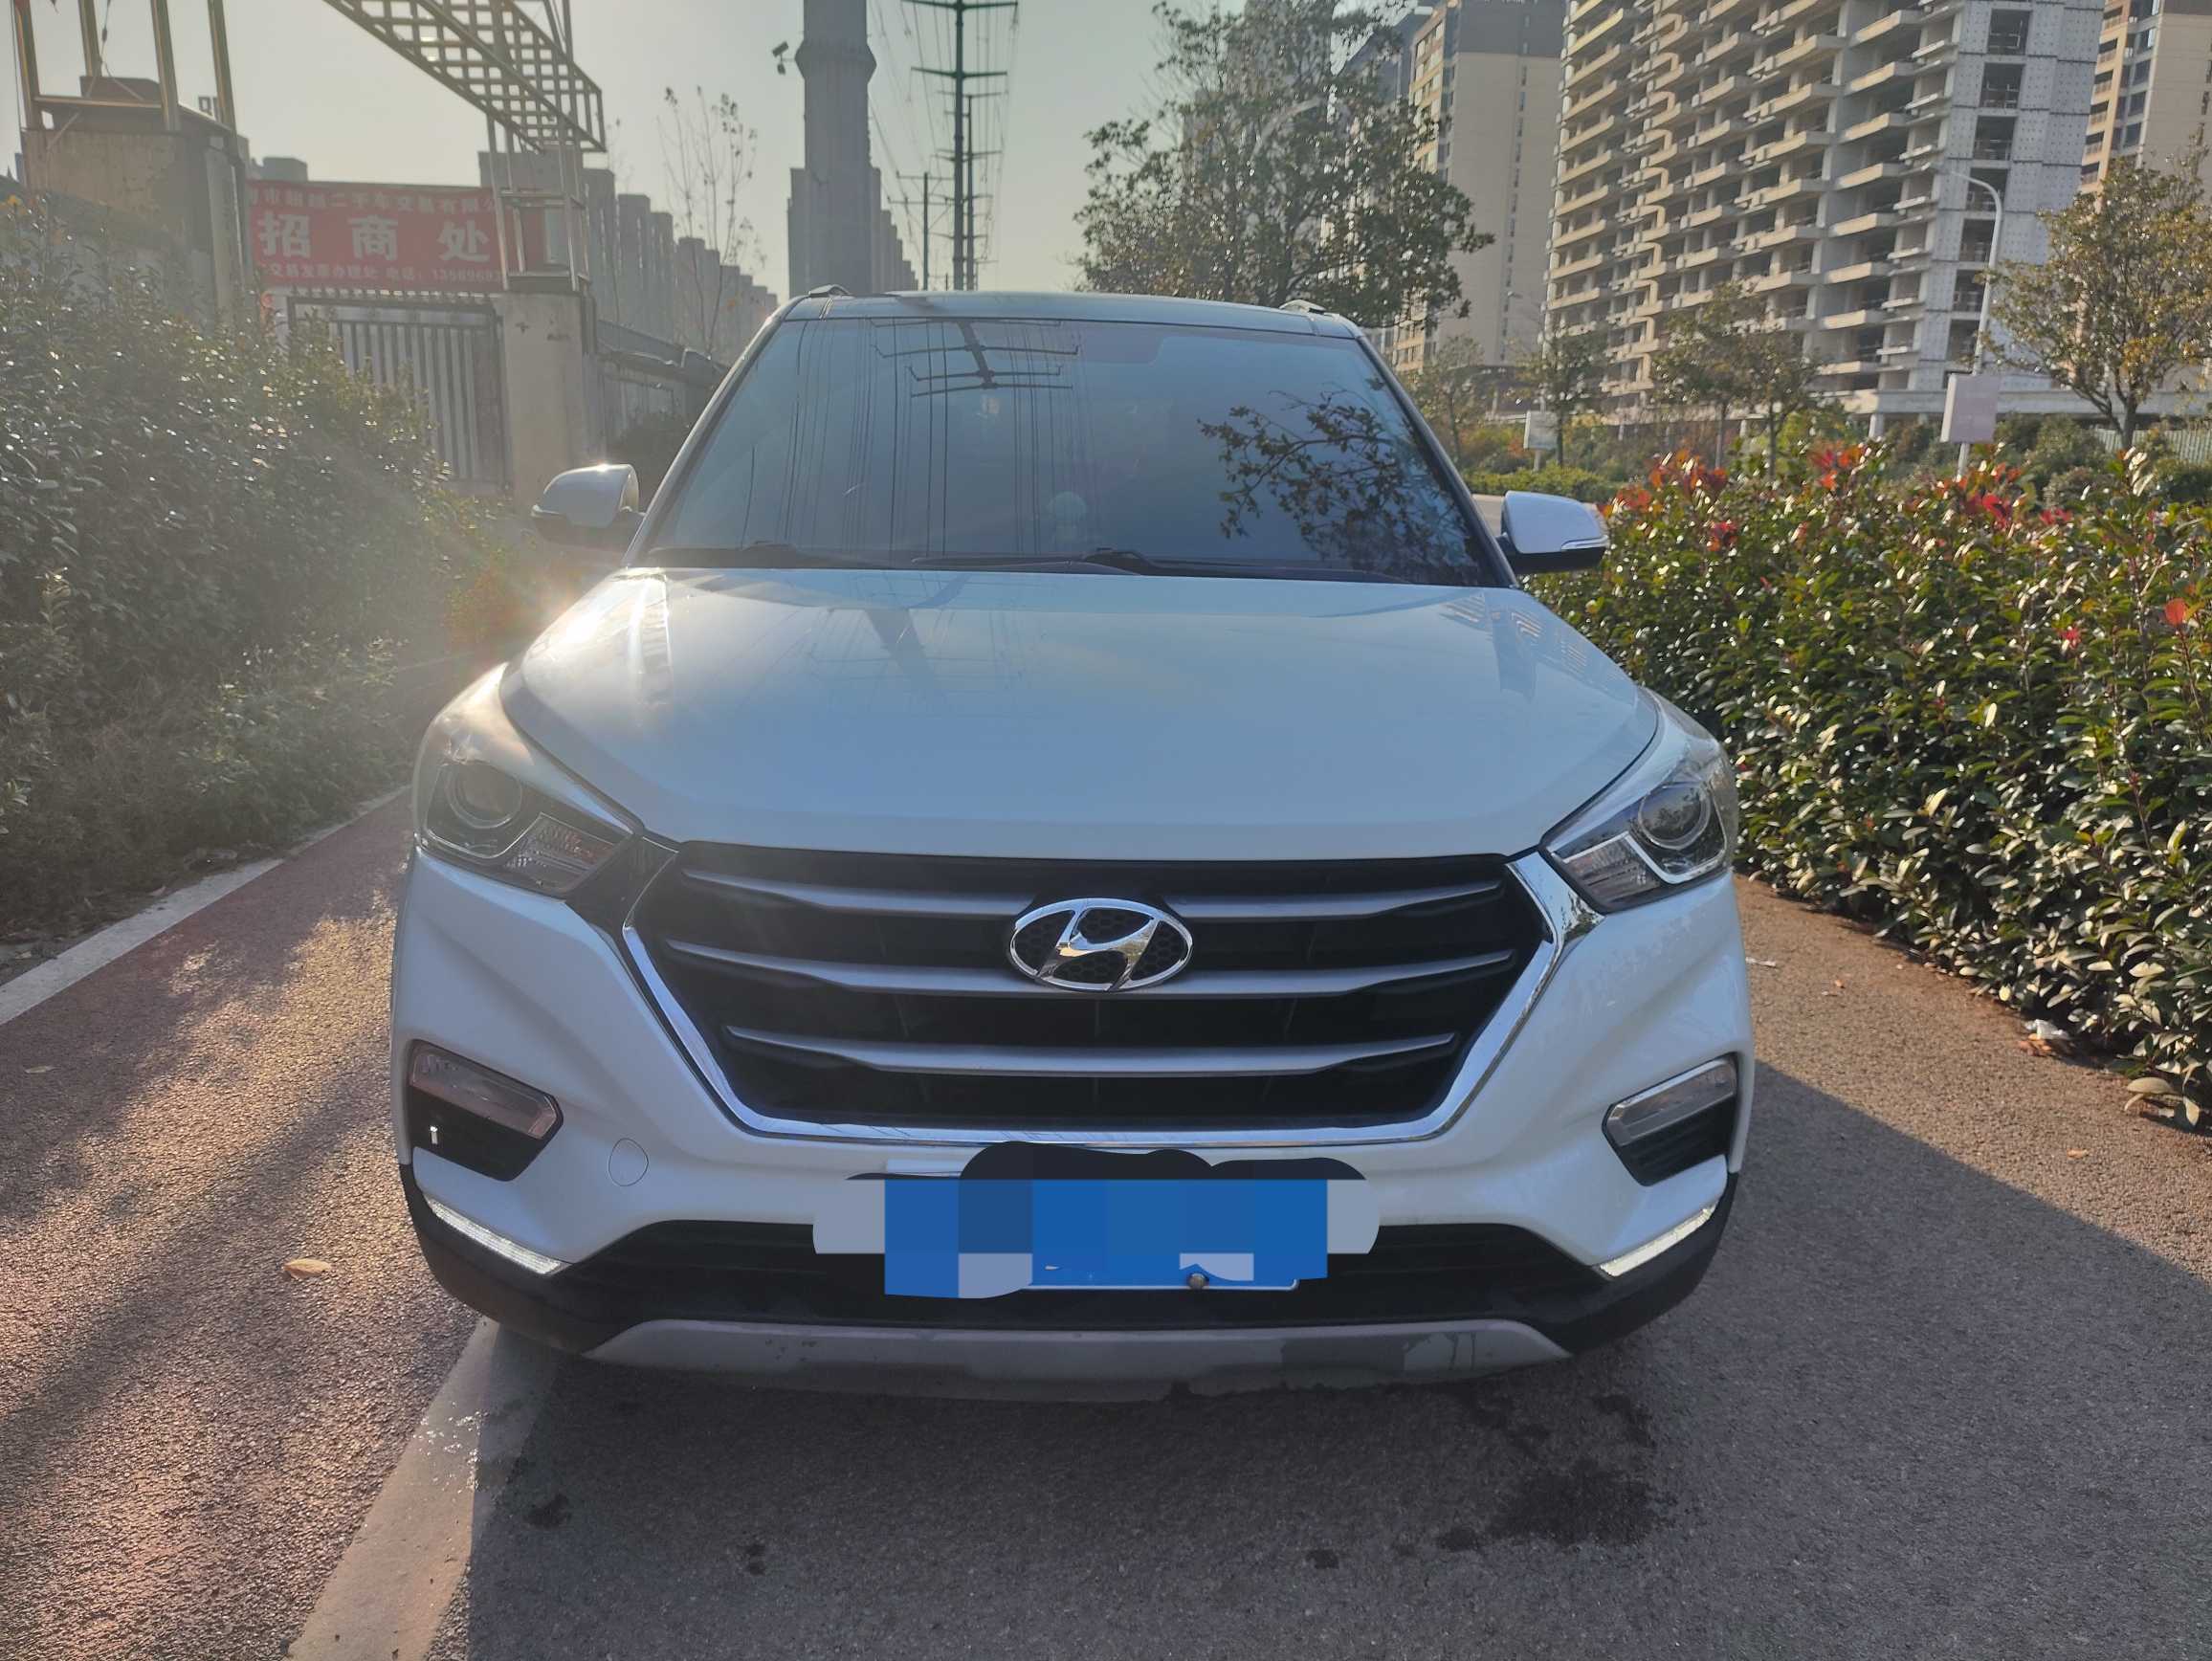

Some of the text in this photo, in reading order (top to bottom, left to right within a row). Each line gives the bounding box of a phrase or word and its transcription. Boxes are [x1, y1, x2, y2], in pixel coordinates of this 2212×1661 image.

[257, 211, 490, 262] 招商处
[259, 262, 380, 279] 交易发票办理处
